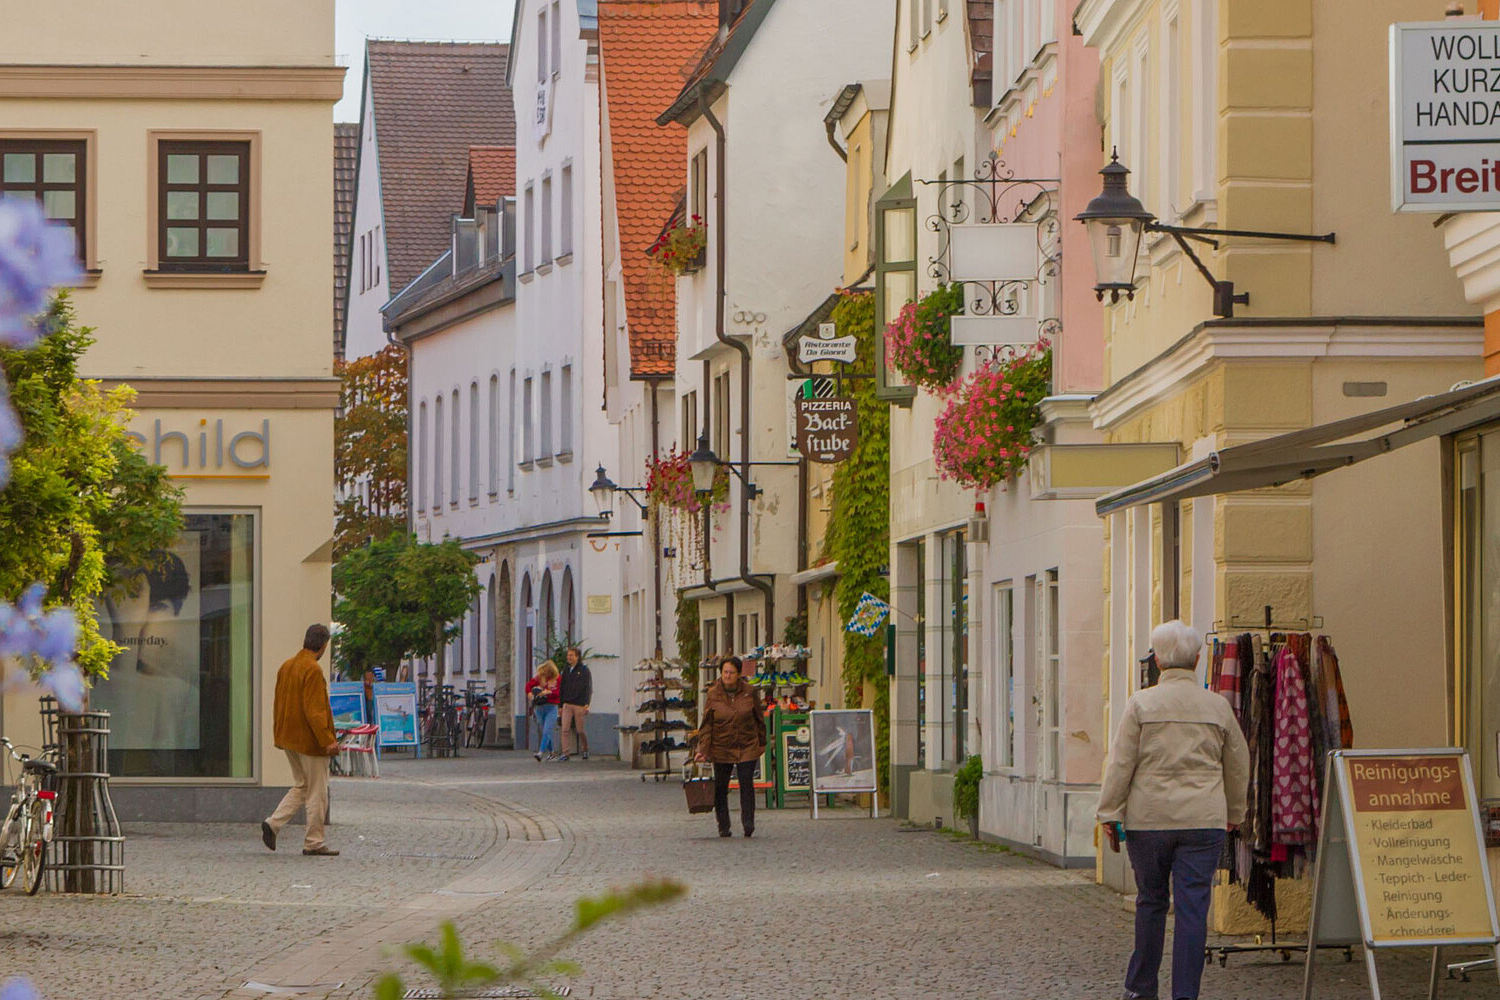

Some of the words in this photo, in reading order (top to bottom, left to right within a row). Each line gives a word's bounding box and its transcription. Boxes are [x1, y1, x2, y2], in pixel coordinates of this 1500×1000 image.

[1434, 68, 1500, 93] KURZ
[801, 402, 851, 411] PIZZERIA
[803, 412, 852, 432] Back-
[1354, 763, 1457, 784] Reinigungs-
[1368, 789, 1451, 807] annahme
[1371, 818, 1433, 830] Kleiderbad
[1373, 836, 1451, 849] Vollreinigung
[1377, 853, 1463, 868] Mangelwäsche
[1378, 872, 1425, 886] Teppich
[1434, 871, 1471, 883] Leder-
[1383, 890, 1443, 904] Reinigung
[1386, 906, 1453, 921] Änderungs-
[1389, 924, 1456, 937] schneiderei
